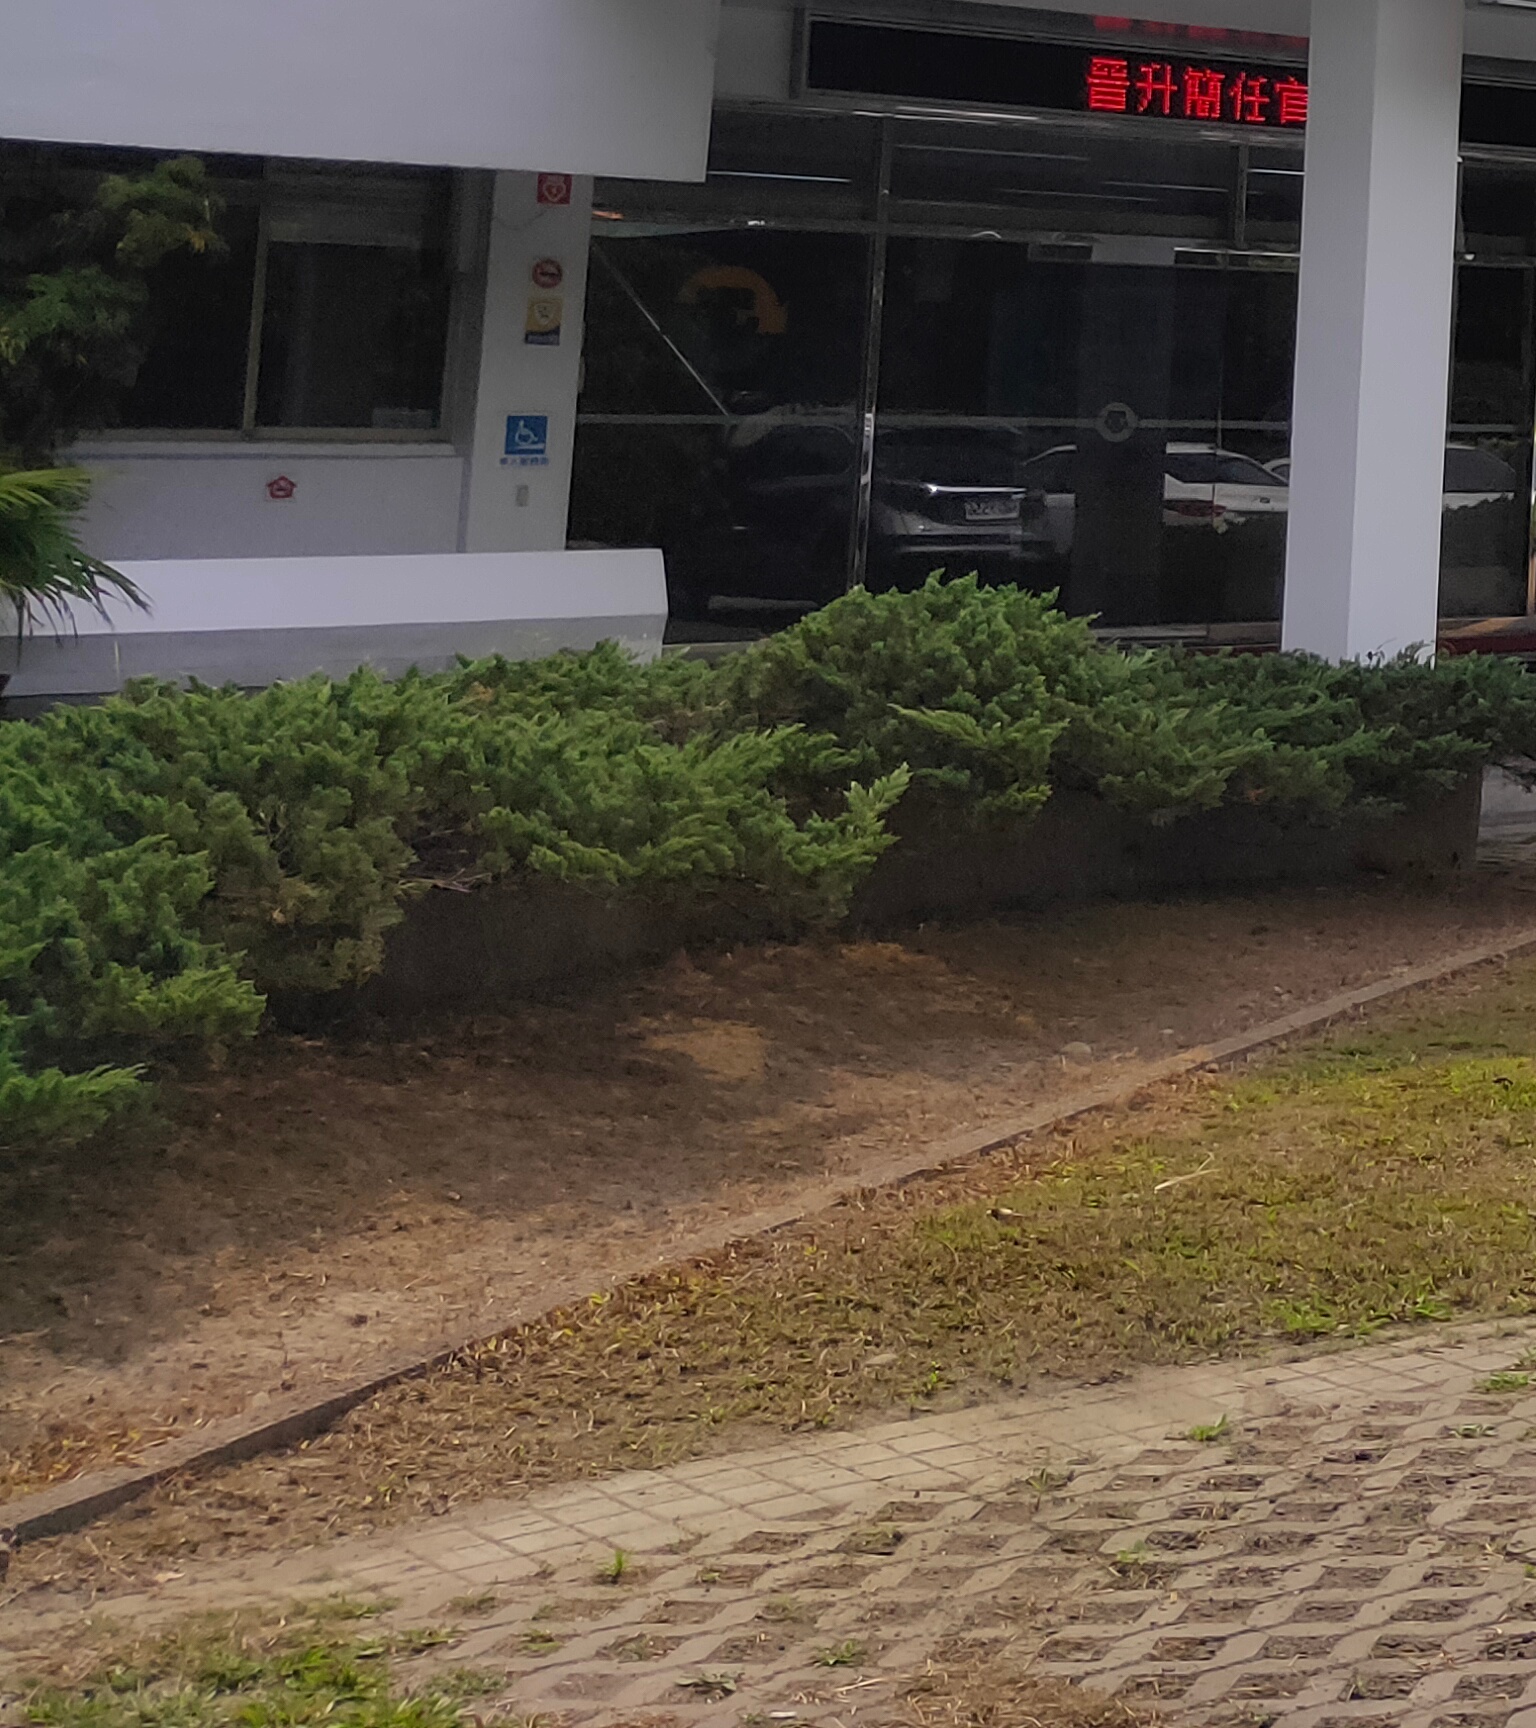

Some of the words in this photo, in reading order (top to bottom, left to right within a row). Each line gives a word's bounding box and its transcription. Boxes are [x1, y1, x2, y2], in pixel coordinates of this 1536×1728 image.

[1088, 57, 1308, 124] 晉升簡任官
